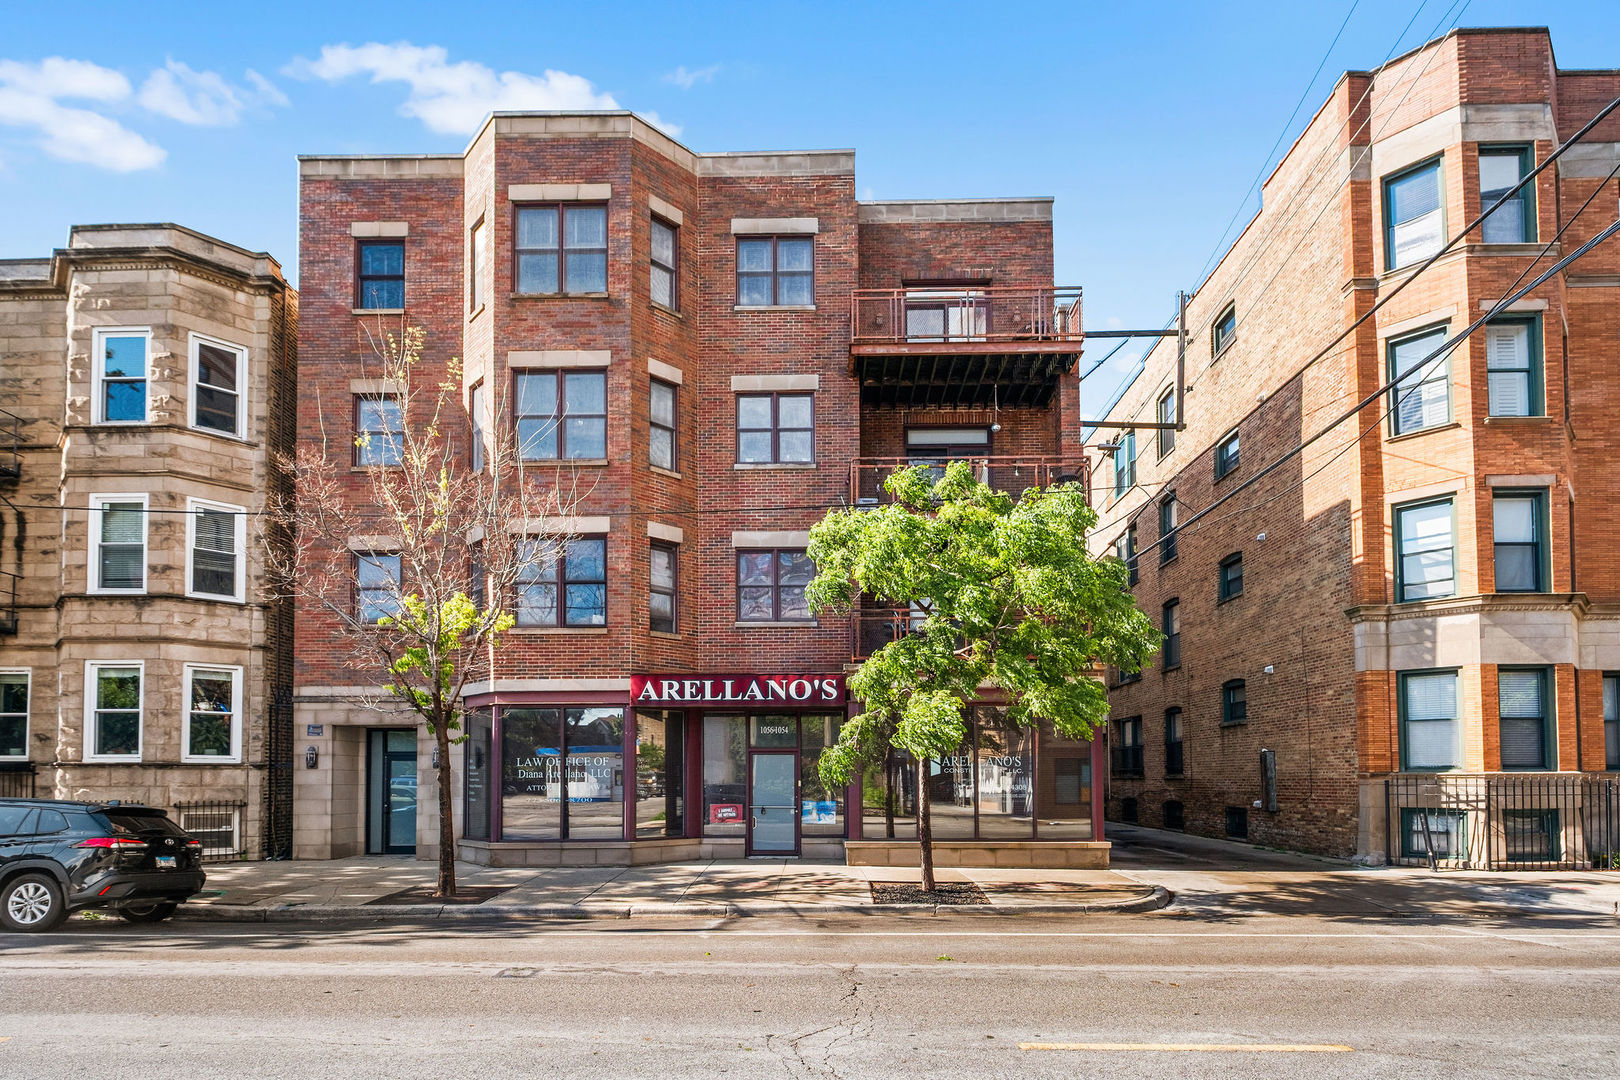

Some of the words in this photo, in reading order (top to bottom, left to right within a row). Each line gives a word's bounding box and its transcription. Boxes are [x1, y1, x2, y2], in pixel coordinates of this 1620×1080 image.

[637, 679, 838, 701] ARELLANO'S
[516, 757, 544, 767] LAW
[594, 756, 610, 767] OF
[518, 769, 543, 779] Diana
[591, 768, 611, 778] LLC
